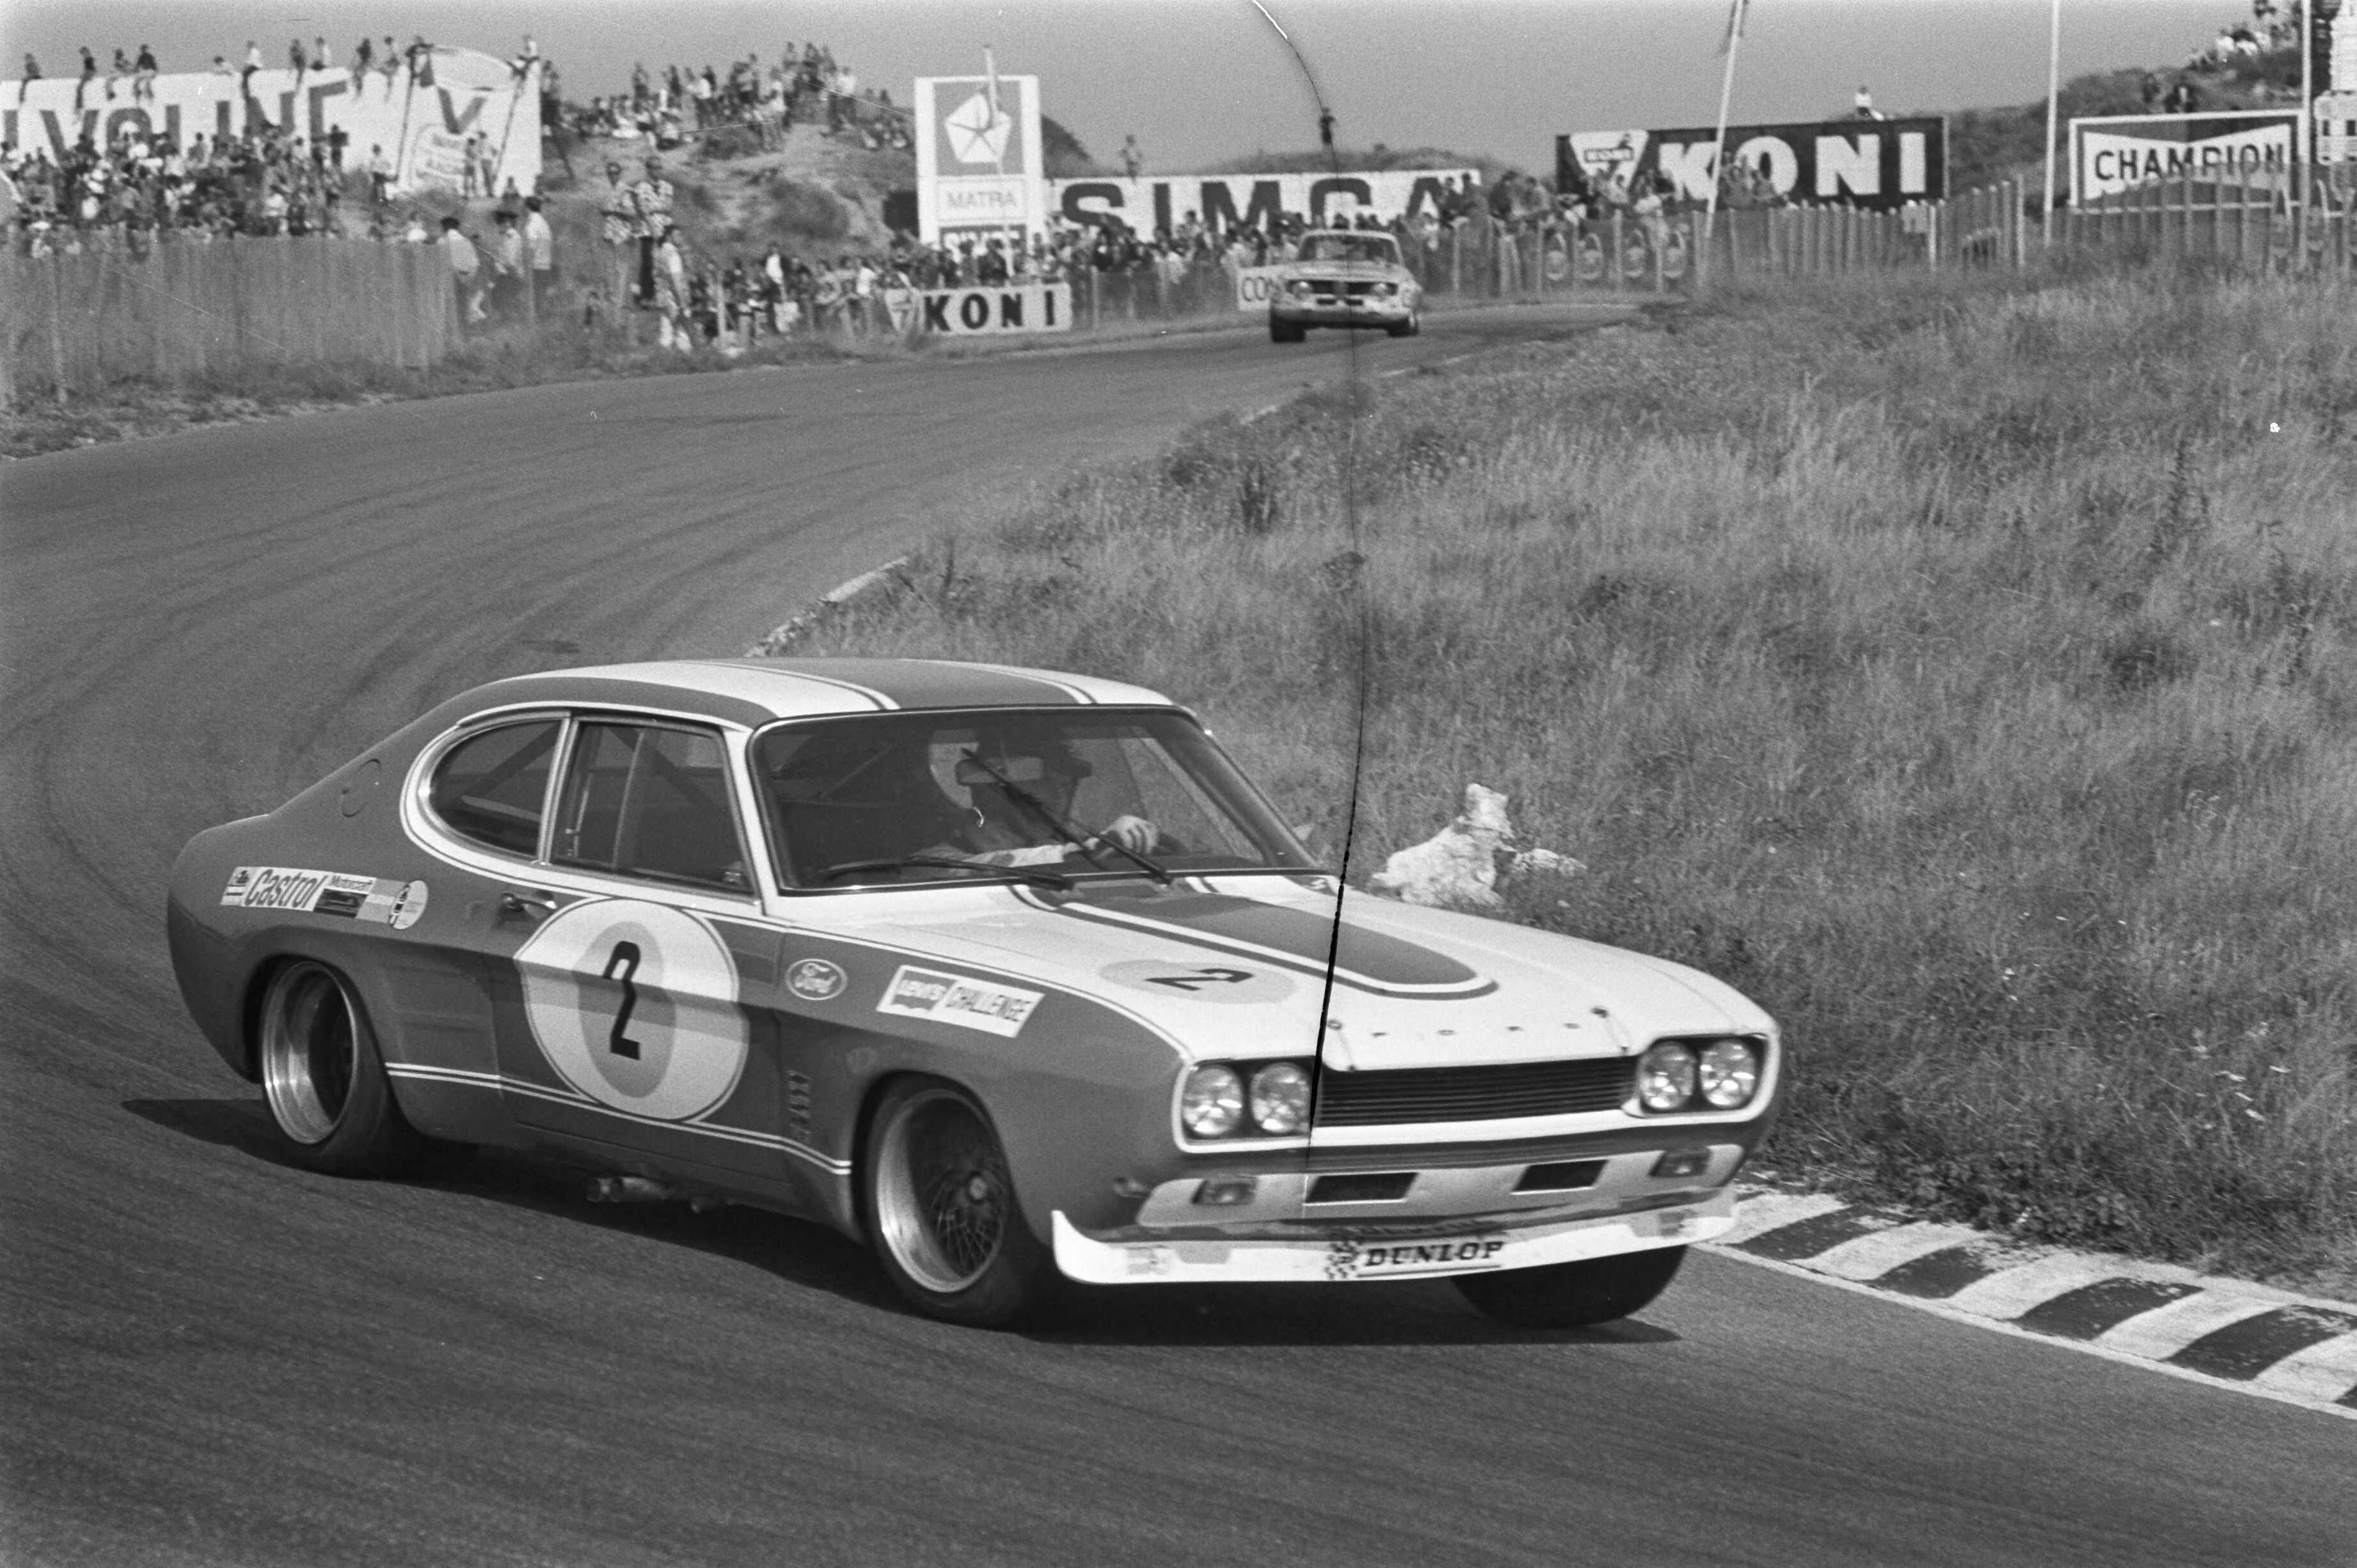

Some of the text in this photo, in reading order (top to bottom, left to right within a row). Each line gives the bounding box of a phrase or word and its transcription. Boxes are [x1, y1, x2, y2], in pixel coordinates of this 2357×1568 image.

[1659, 131, 1926, 201] KONI
[2095, 143, 2283, 181] CHAMPION
[947, 191, 1018, 209] MATRA
[924, 290, 1055, 332] KONI
[245, 869, 328, 908] Castrol
[795, 962, 837, 994] Ford
[1143, 968, 1255, 991] 2
[603, 940, 641, 1061] 2
[946, 985, 1031, 1022] CHALLENGE
[1365, 1241, 1505, 1267] DUNLOP
